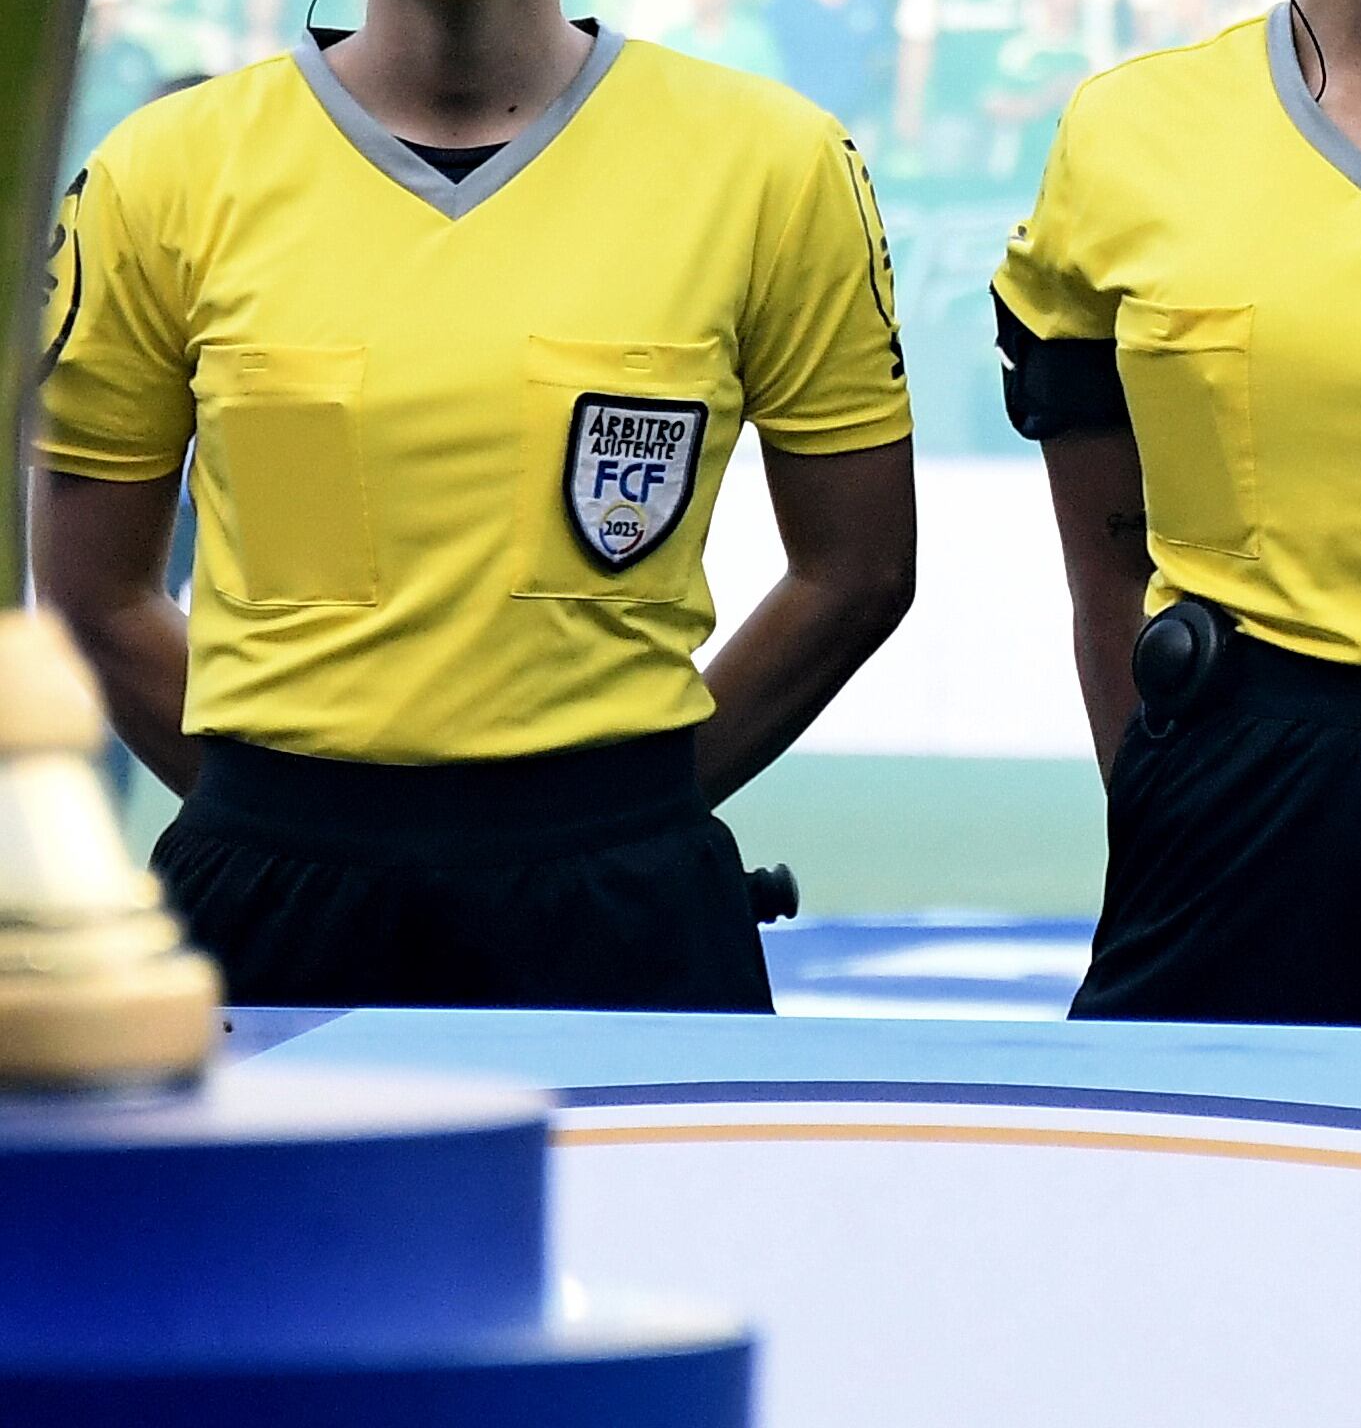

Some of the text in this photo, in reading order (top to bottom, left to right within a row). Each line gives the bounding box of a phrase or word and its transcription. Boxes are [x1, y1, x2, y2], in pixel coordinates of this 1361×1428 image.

[589, 408, 686, 443] ÁRBITRO
[591, 437, 676, 461] ASISTENTE
[594, 461, 667, 503] FCF
[604, 521, 639, 537] 2025
